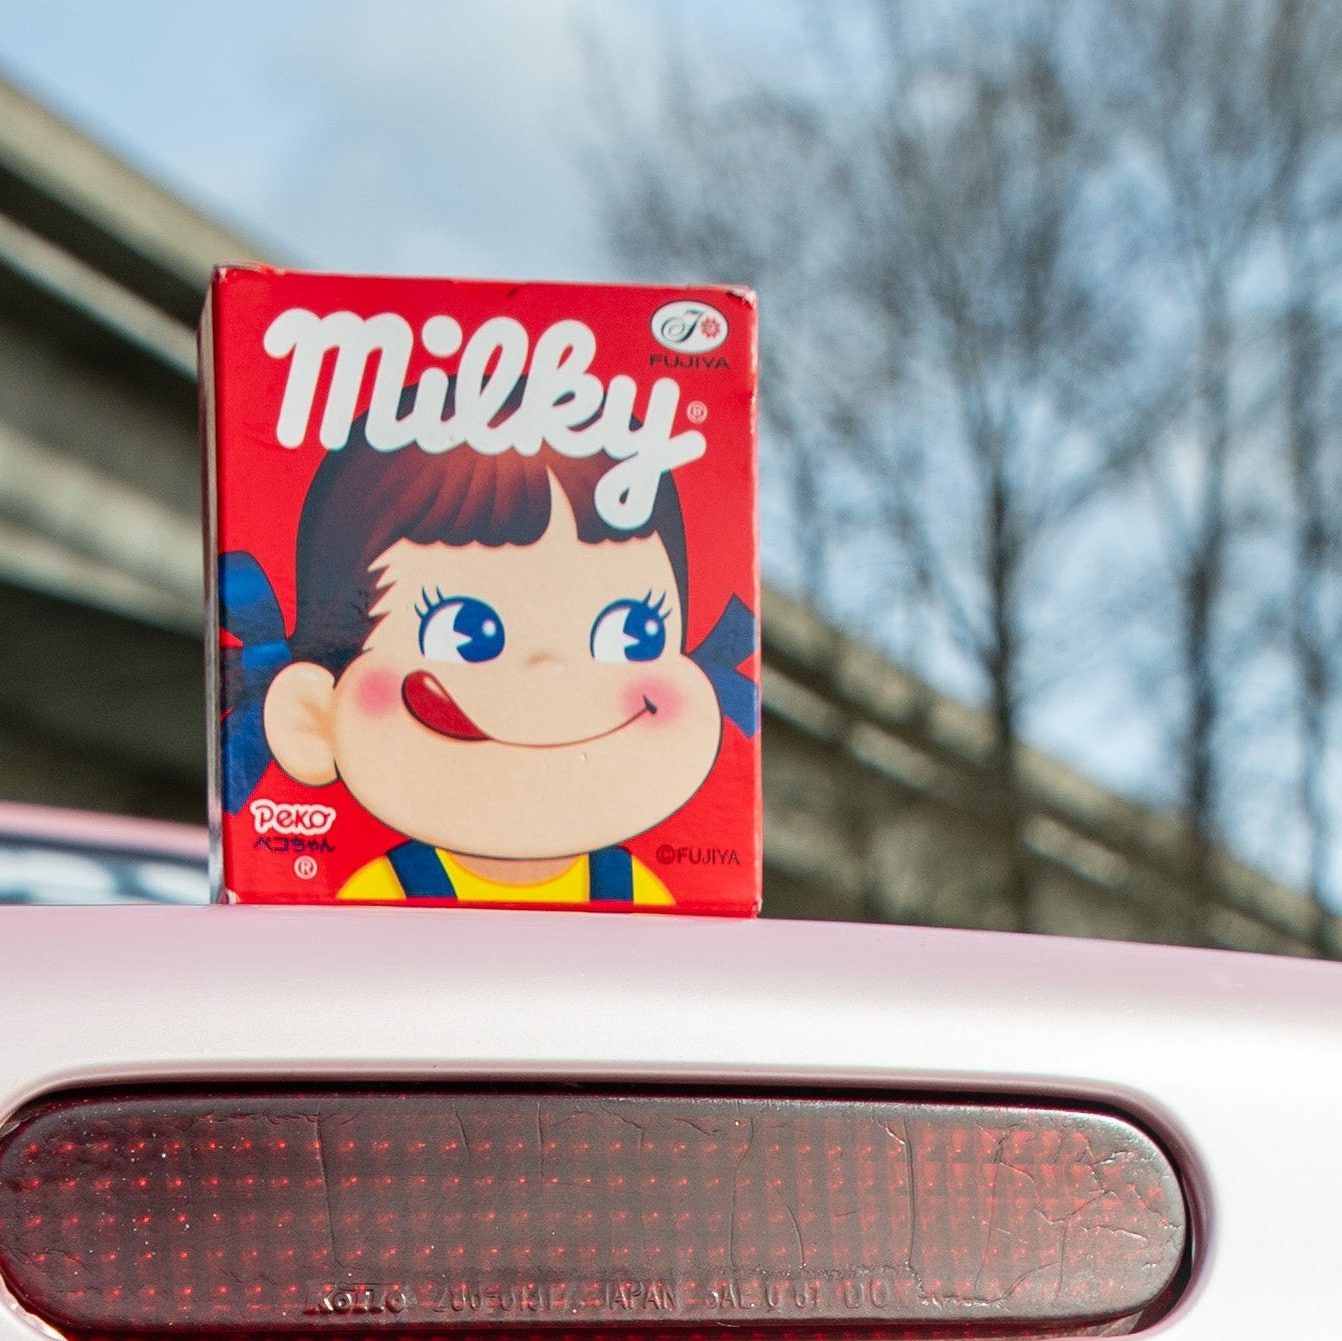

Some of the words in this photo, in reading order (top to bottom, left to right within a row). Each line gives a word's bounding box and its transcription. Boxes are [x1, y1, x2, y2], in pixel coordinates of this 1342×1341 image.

[649, 353, 730, 370] FUJIYA
[264, 308, 706, 529] Milky
[254, 836, 335, 853] ペコちゃん
